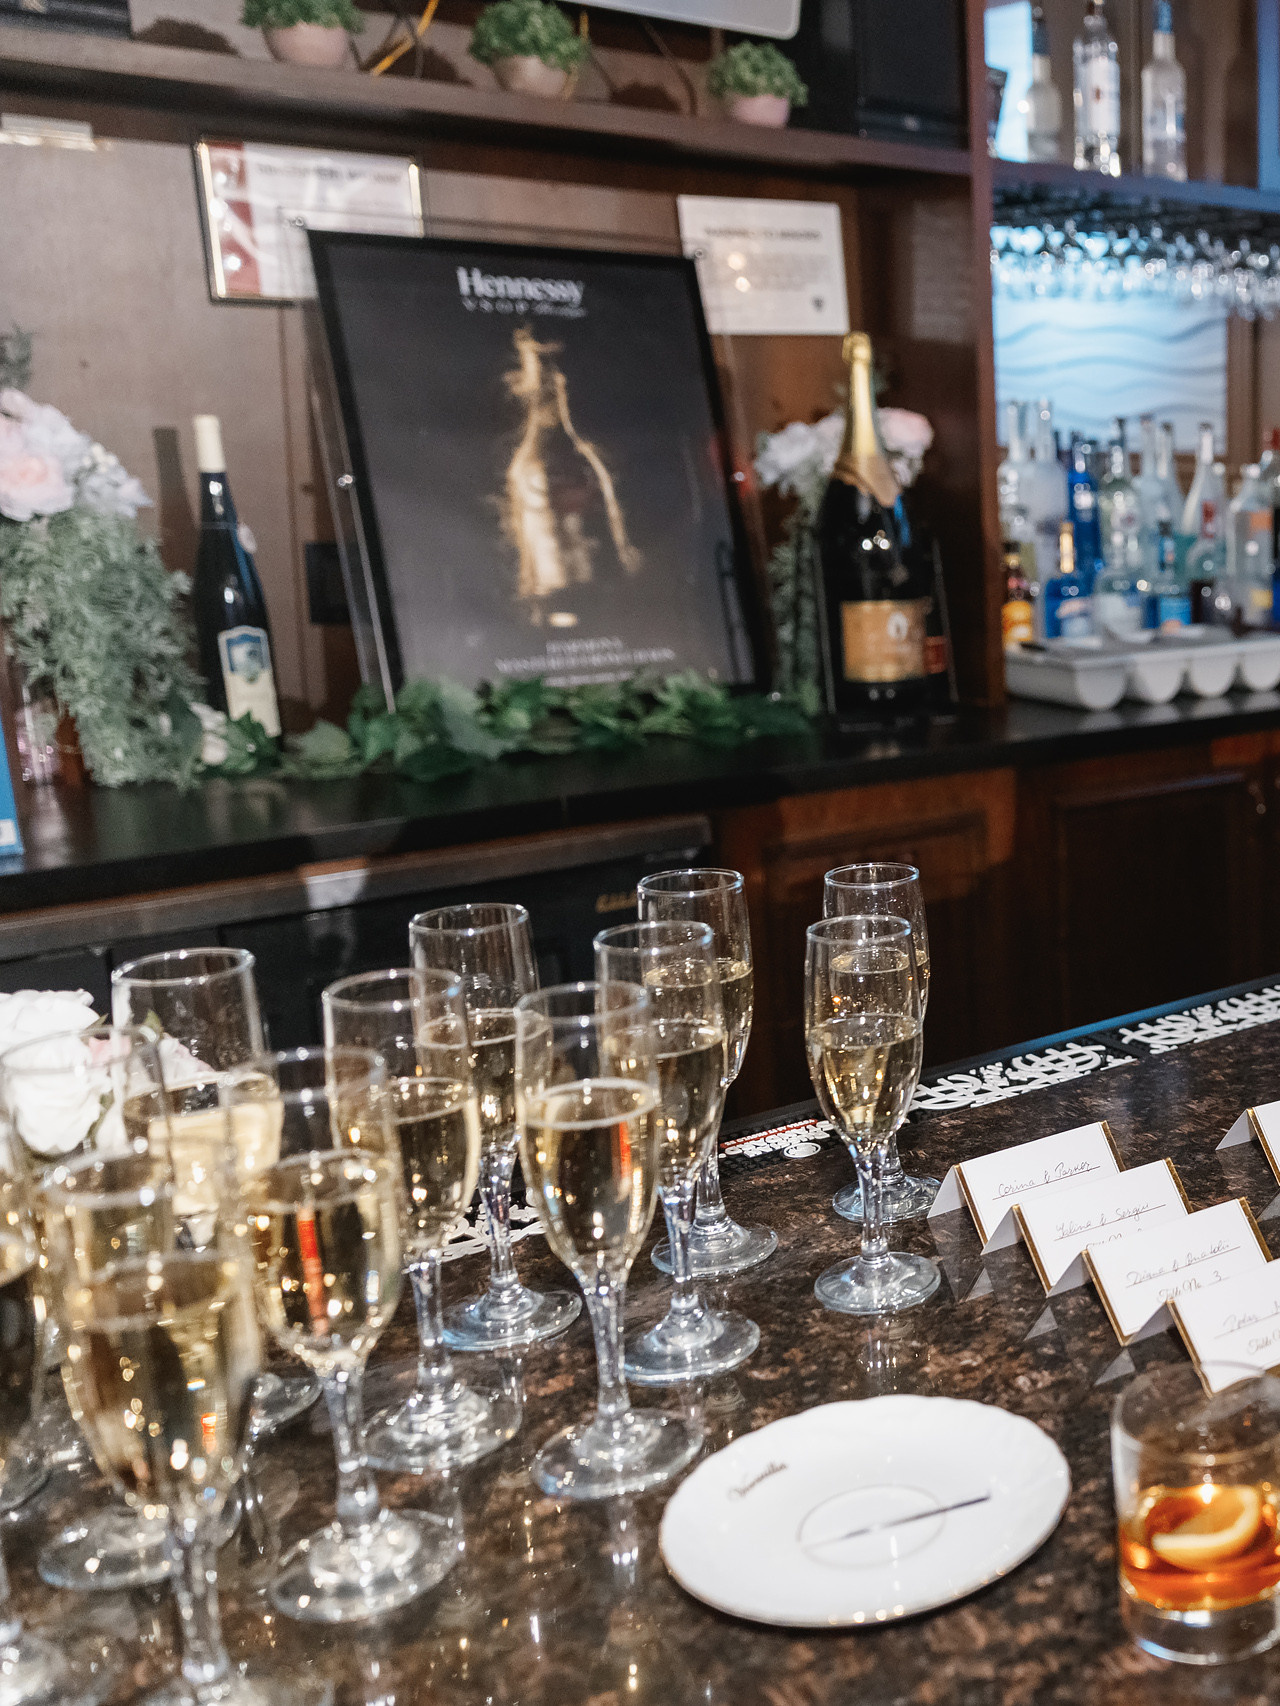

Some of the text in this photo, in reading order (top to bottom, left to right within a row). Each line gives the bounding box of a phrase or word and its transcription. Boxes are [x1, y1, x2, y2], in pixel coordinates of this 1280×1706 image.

[724, 1120, 835, 1156] STANDARD
[998, 1180, 1035, 1197] Corina
[1044, 1170, 1051, 1184] &
[1099, 1213, 1107, 1226] &
[1126, 1267, 1166, 1284] Diana
[1247, 1337, 1272, 1355] Table
